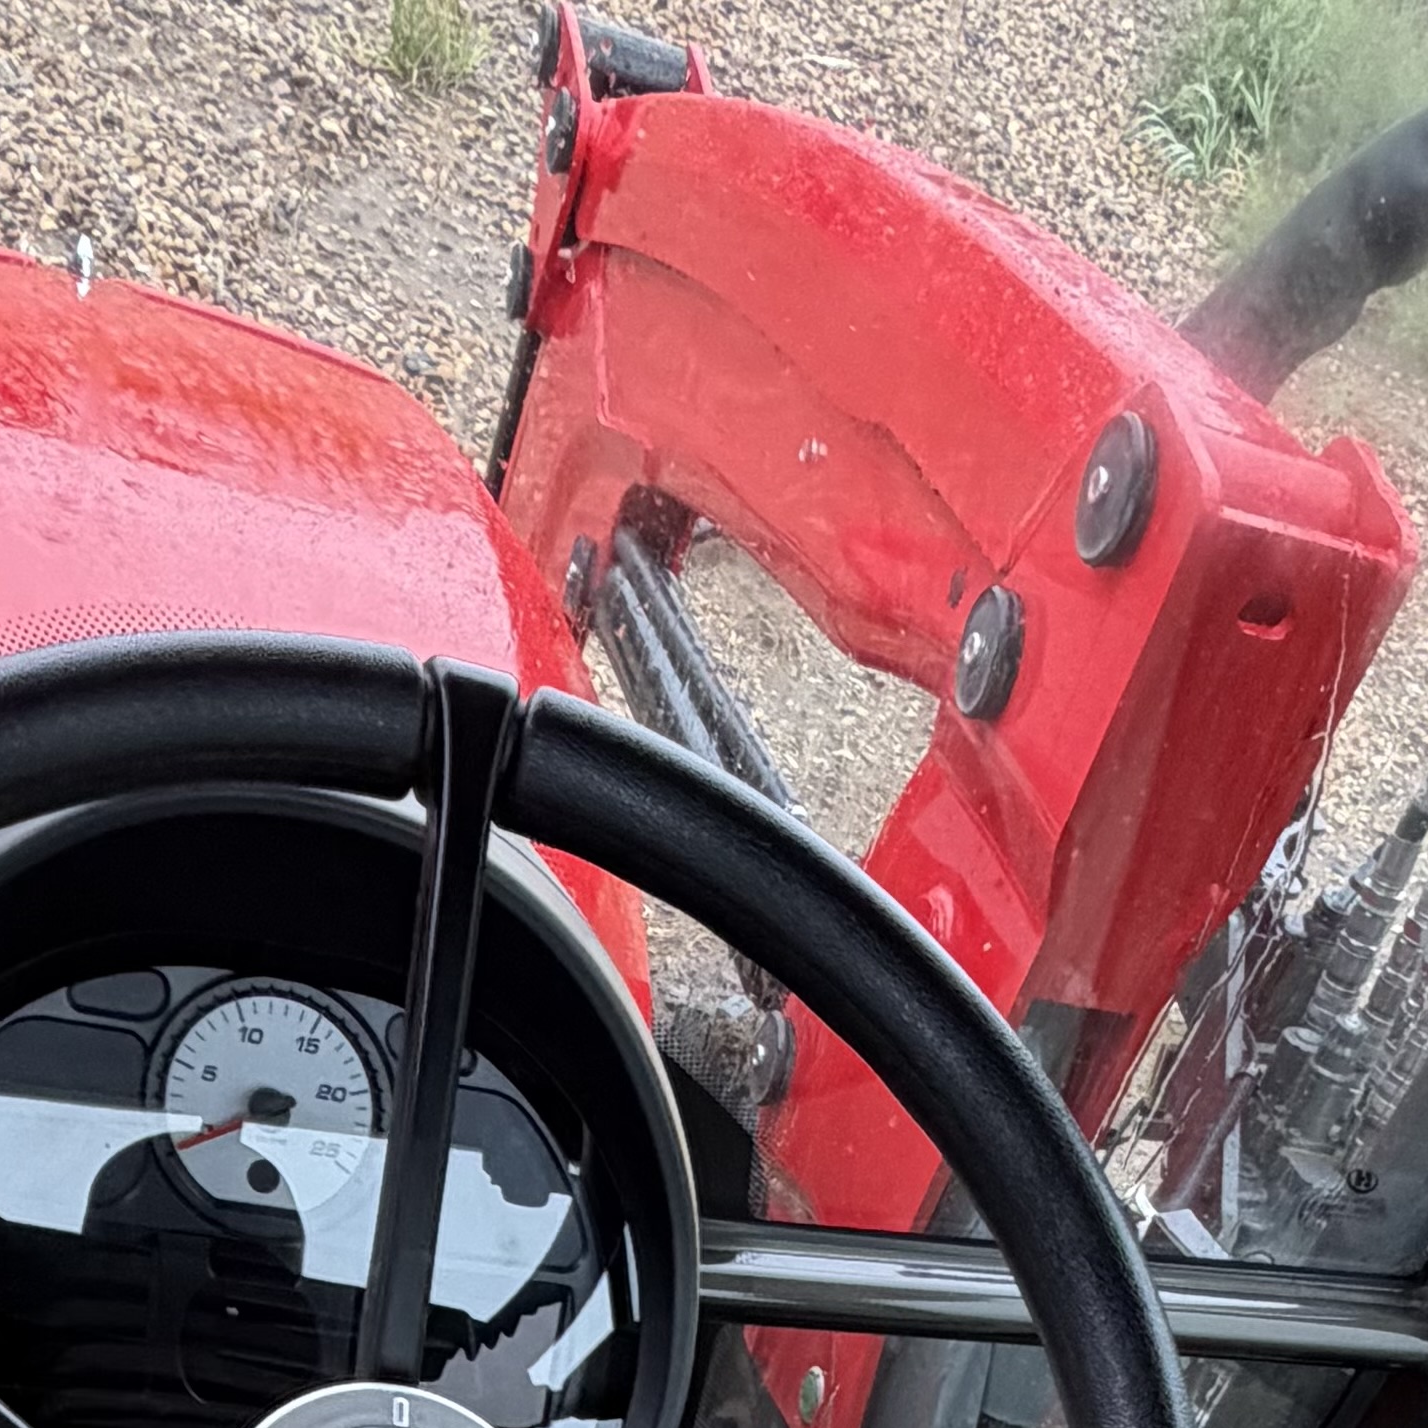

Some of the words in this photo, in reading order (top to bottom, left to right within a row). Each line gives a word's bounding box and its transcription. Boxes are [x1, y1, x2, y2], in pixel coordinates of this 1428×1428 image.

[238, 1027, 263, 1045] 10
[296, 1036, 320, 1055] 15
[201, 1065, 218, 1082] 5
[316, 1084, 348, 1103] 20
[310, 1140, 340, 1159] 25
